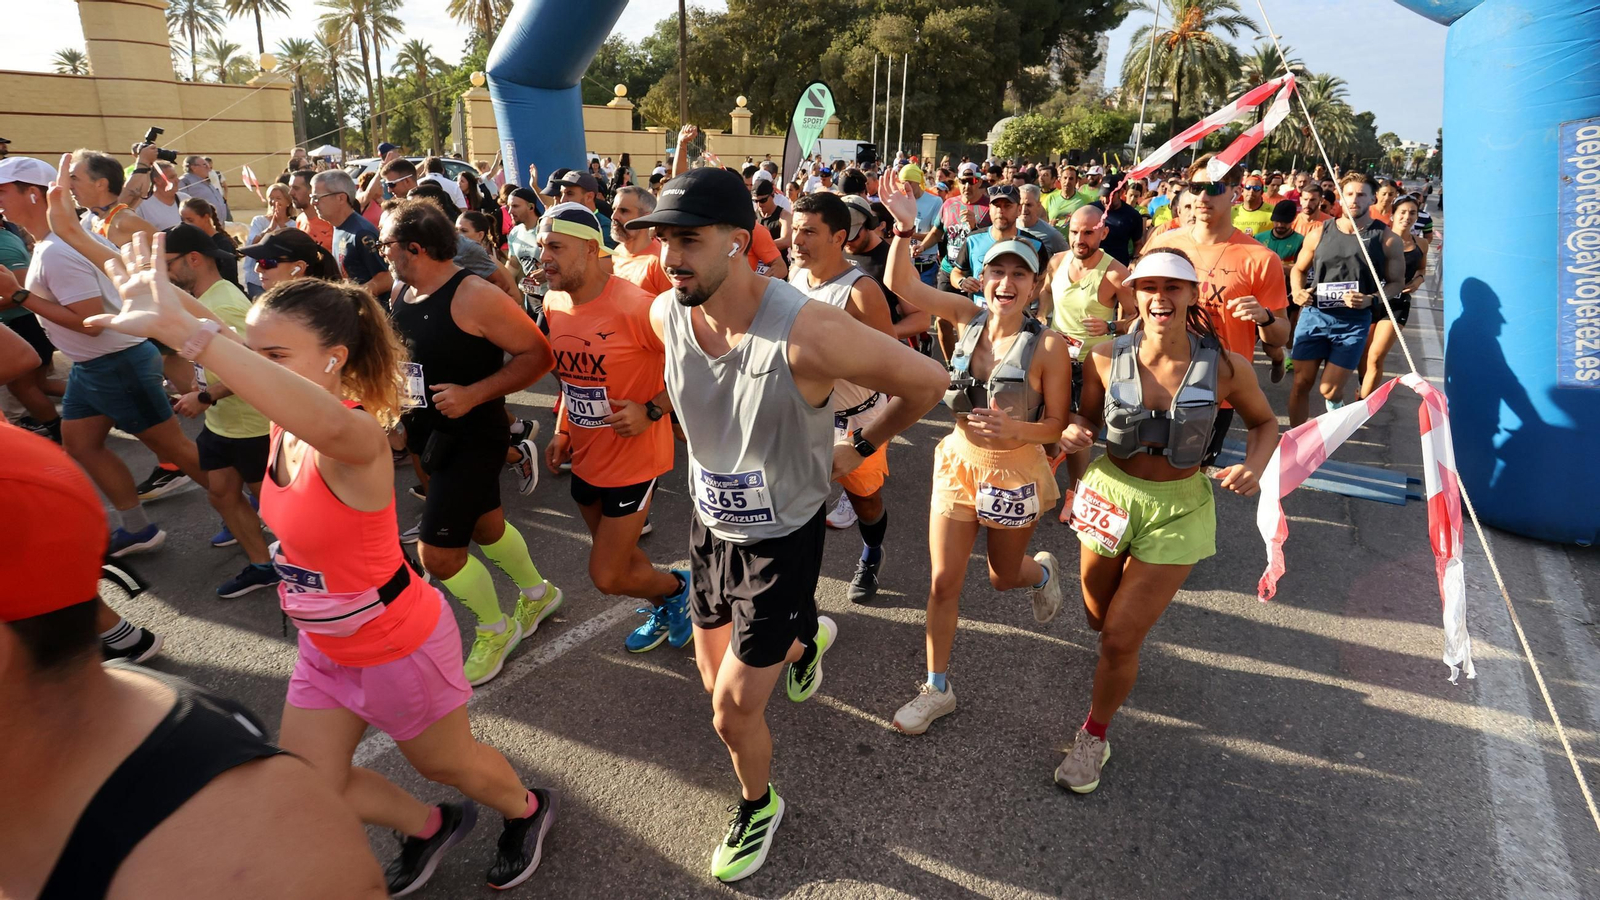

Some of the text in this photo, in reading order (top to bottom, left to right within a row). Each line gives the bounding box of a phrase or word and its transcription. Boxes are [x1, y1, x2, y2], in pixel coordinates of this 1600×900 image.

[1325, 291, 1350, 301] 102
[571, 398, 595, 416] 701
[706, 487, 747, 509] 865
[991, 499, 1025, 516] 678
[1080, 503, 1110, 529] 376
[720, 512, 768, 523] MIZUNO
